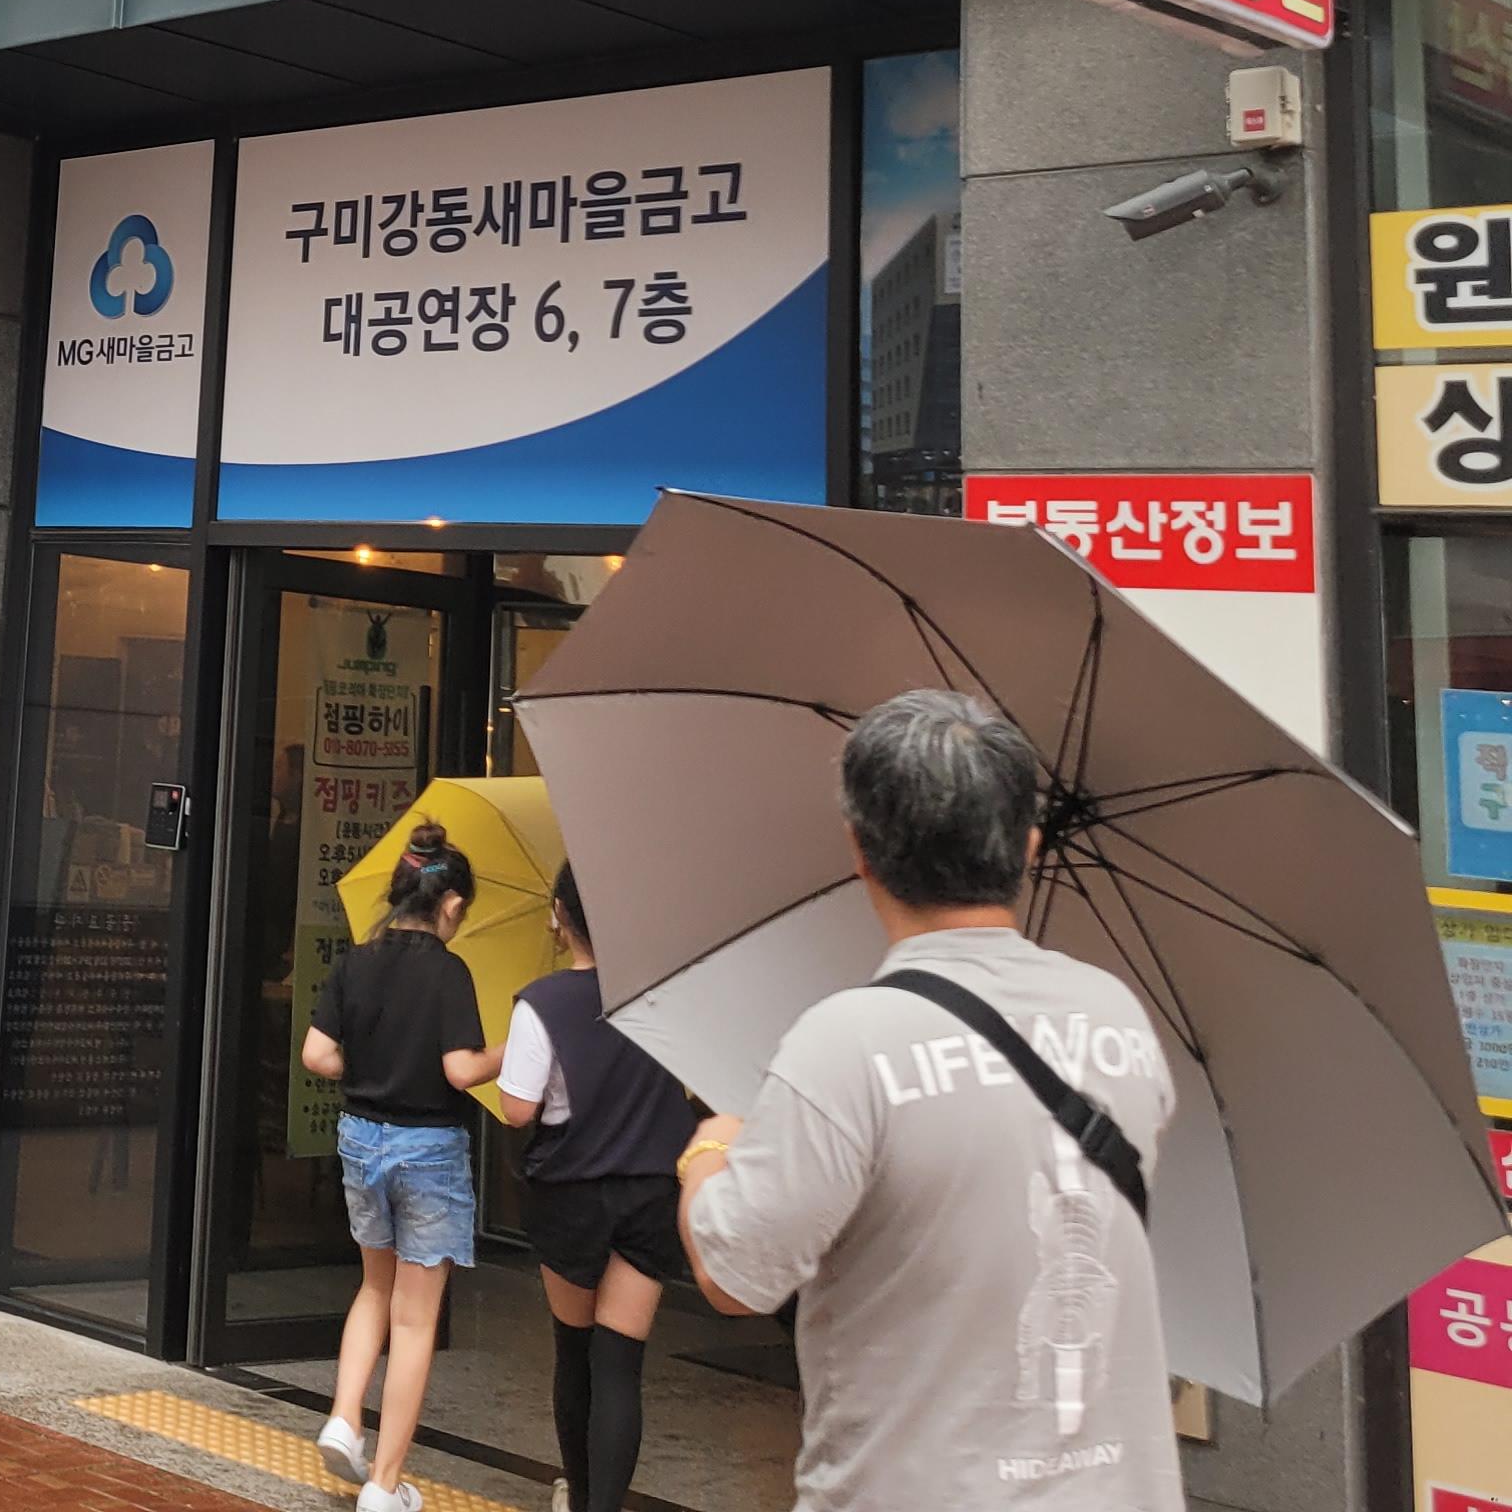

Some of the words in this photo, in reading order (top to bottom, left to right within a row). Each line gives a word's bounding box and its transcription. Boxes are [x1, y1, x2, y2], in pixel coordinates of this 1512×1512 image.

[285, 161, 748, 264] 구미강동새마을금고
[322, 283, 516, 359] 대공연장
[534, 280, 580, 355] 6,
[607, 270, 694, 346] 7층
[57, 333, 195, 367] MG새마을금고
[324, 701, 409, 737] 점핑하이
[314, 776, 412, 813] 점핑키즈
[873, 1033, 1014, 1106] LIFE
[998, 1441, 1125, 1481] HIDEAWAY
